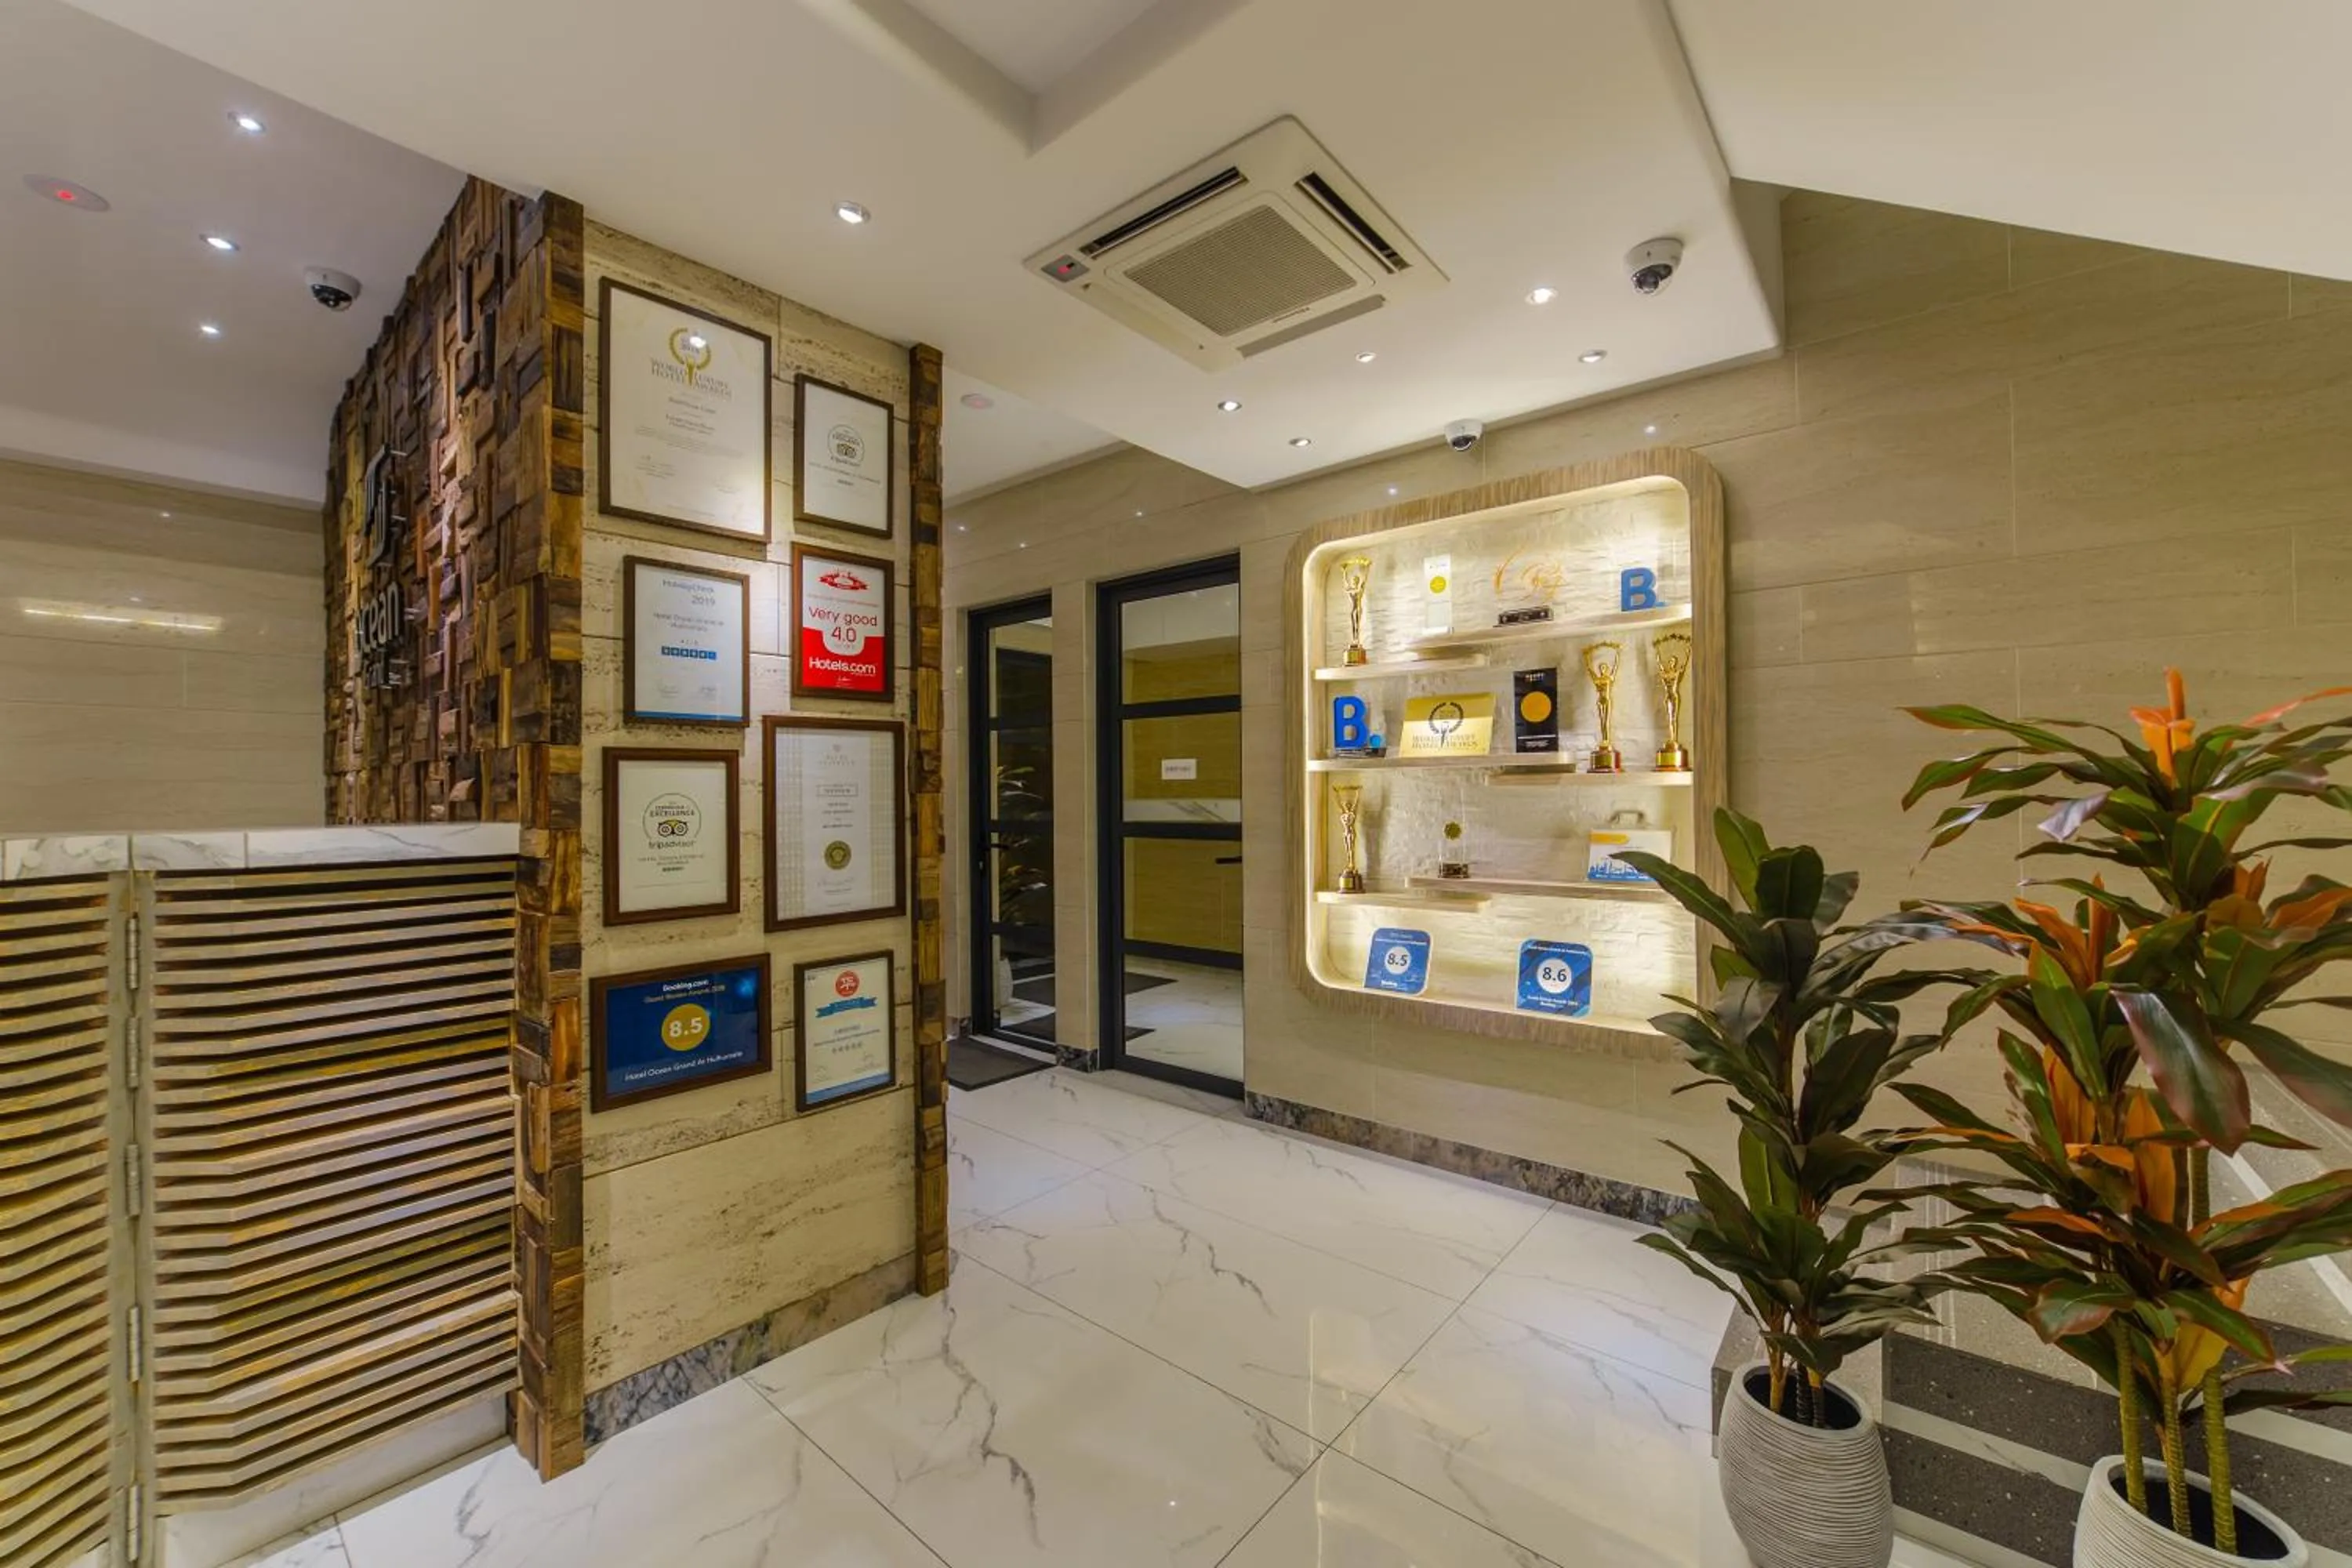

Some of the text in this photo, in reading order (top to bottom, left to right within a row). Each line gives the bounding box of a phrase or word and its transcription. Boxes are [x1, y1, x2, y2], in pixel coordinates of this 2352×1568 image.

[808, 605, 878, 626] Very good
[831, 626, 857, 642] 4.0
[809, 656, 877, 674] Hotels.com
[1387, 953, 1409, 966] 8.5
[1542, 967, 1566, 982] 8.6
[669, 1017, 703, 1038] 8.5
